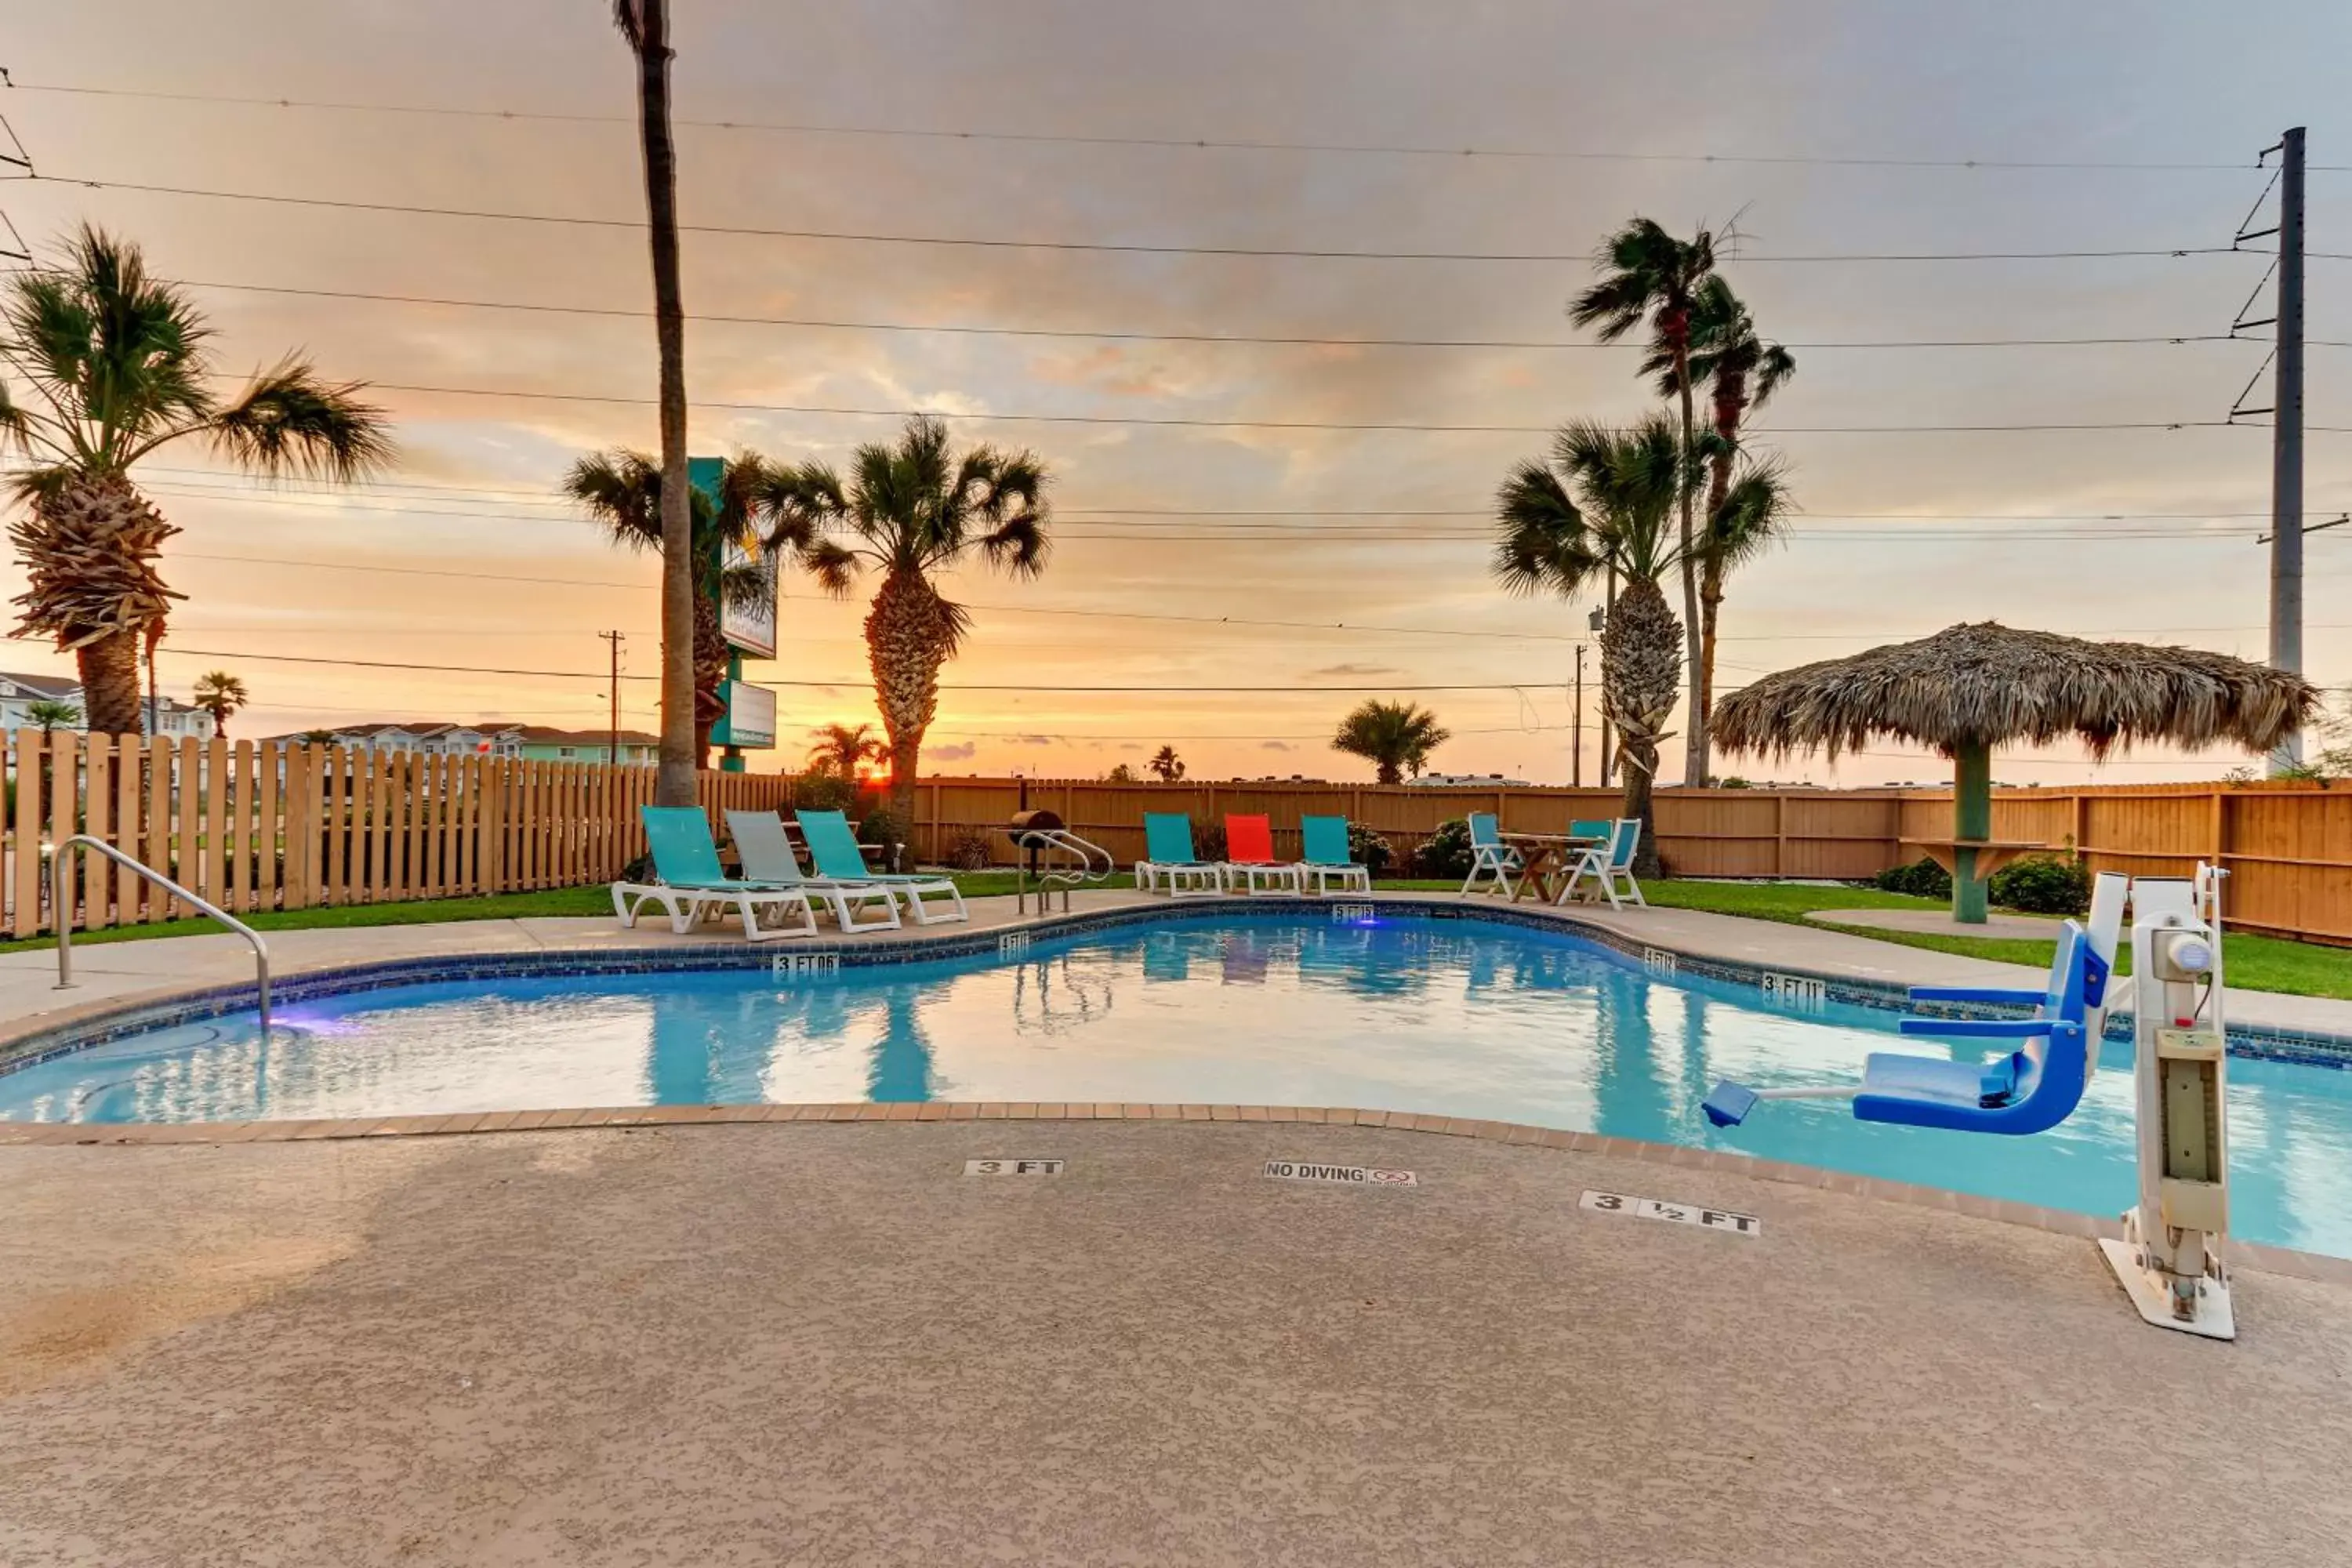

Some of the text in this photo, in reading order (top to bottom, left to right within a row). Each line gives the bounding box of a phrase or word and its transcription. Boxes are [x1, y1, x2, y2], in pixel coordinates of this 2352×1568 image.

[779, 956, 789, 971] 3
[797, 956, 815, 971] FT
[1784, 978, 1802, 999] FT
[978, 1161, 1061, 1174] 3 FT
[1266, 1163, 1363, 1181] NO DIVING
[1595, 1196, 1623, 1210] 3
[1702, 1210, 1757, 1232] FT
